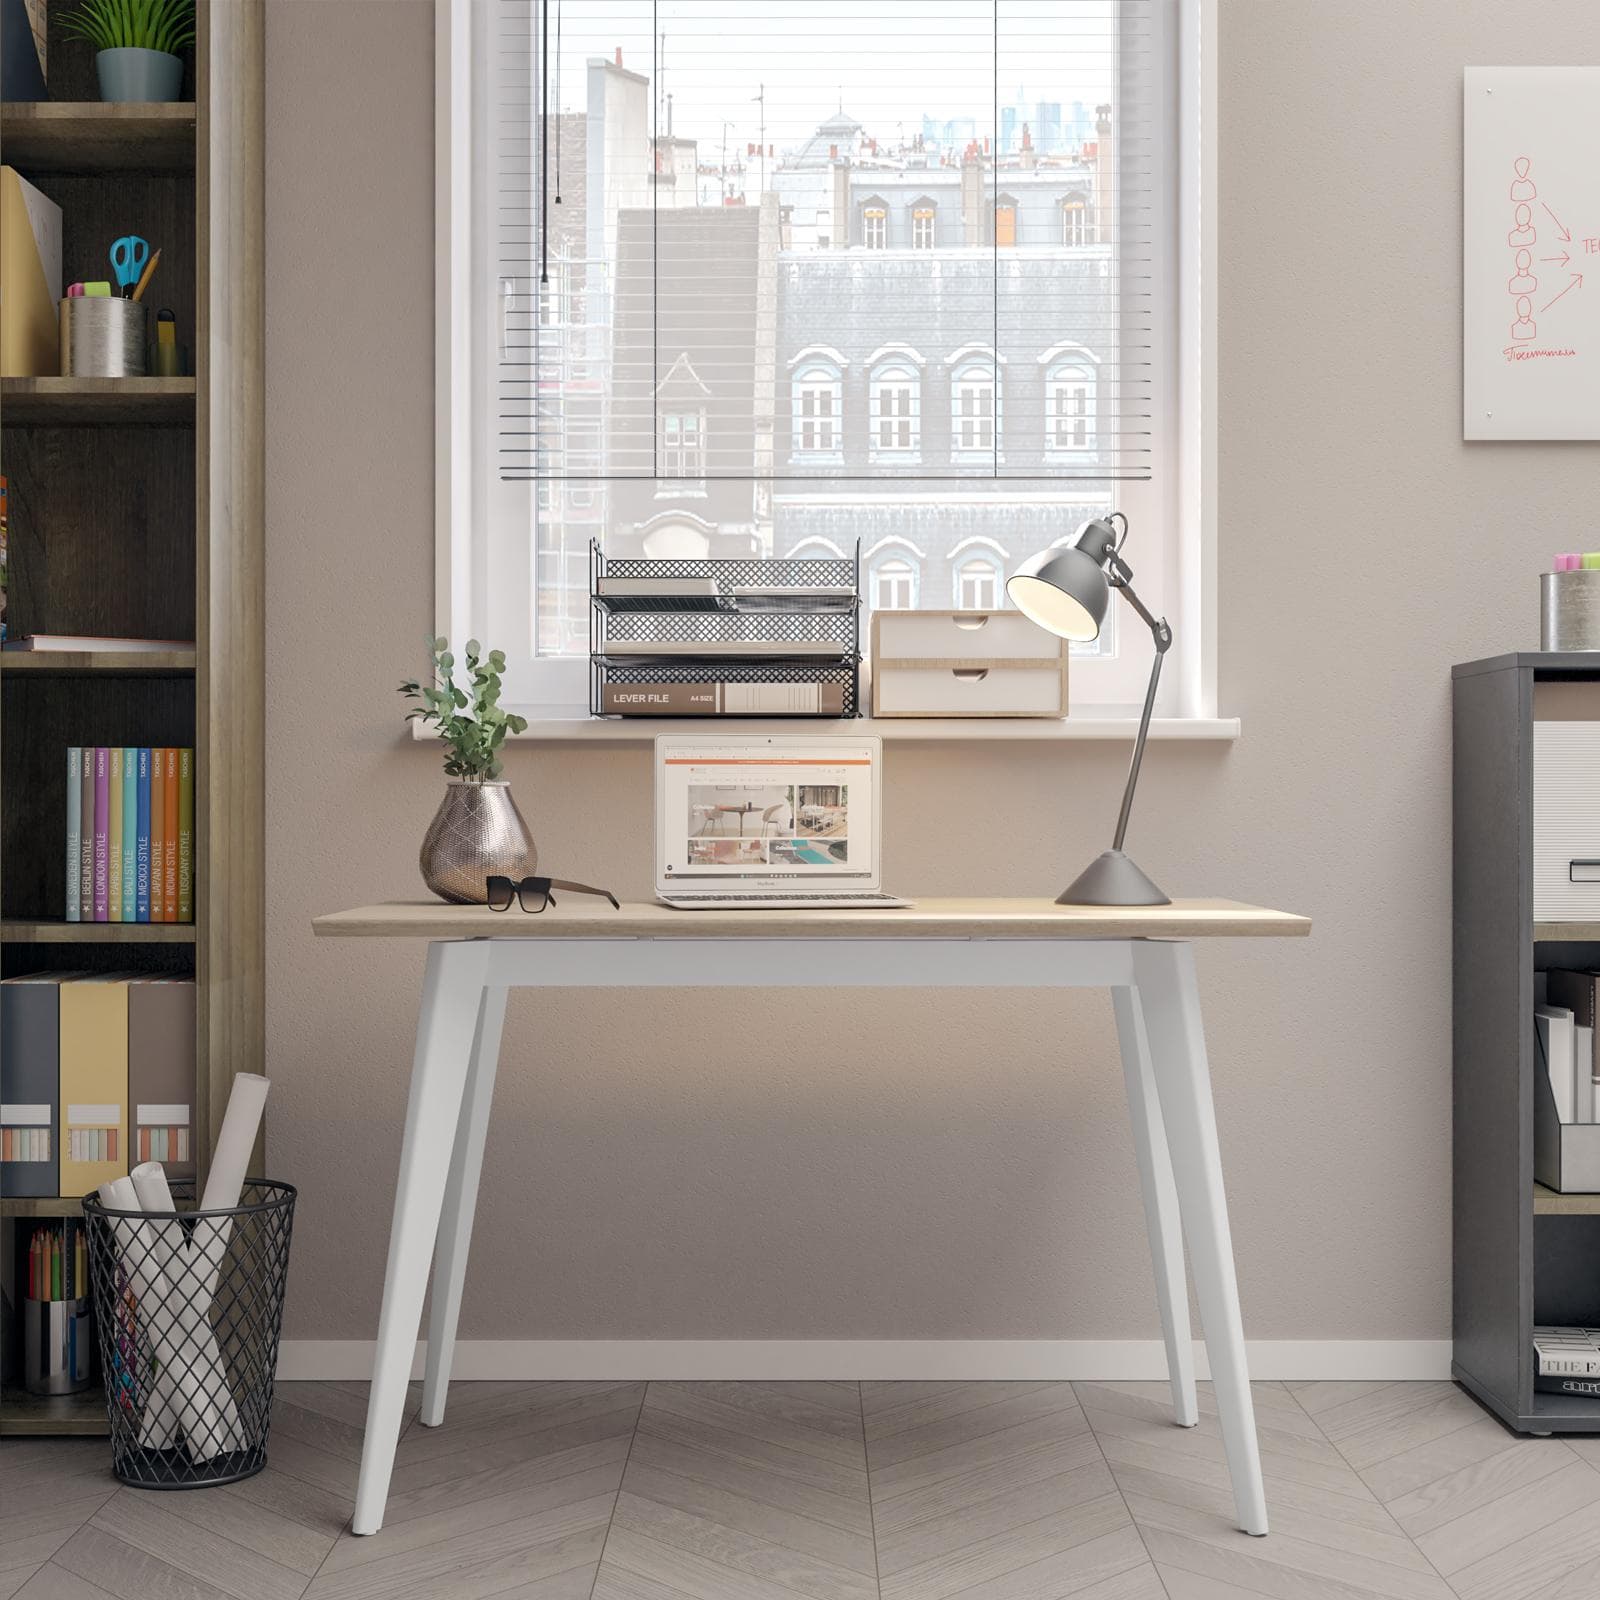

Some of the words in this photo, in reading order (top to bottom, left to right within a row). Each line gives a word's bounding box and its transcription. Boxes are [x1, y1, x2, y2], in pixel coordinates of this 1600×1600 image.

[613, 694, 646, 703] LEVER
[648, 694, 669, 703] FILE
[70, 832, 79, 857] STYLE
[83, 839, 92, 864] STYLE
[97, 833, 106, 858] STYLE
[112, 843, 120, 868] STYLE
[139, 836, 148, 861] STYLE
[153, 841, 162, 866] STYLE
[167, 841, 176, 866] STYLE
[181, 831, 190, 856] STYLE
[125, 850, 134, 875] STYLE
[69, 859, 78, 895] SWEDEN
[82, 866, 91, 895] BERLIN
[96, 860, 105, 895] LONDON
[138, 864, 147, 895] MEXICO
[152, 868, 161, 895] JAPAN
[180, 857, 189, 895] TUSCANY
